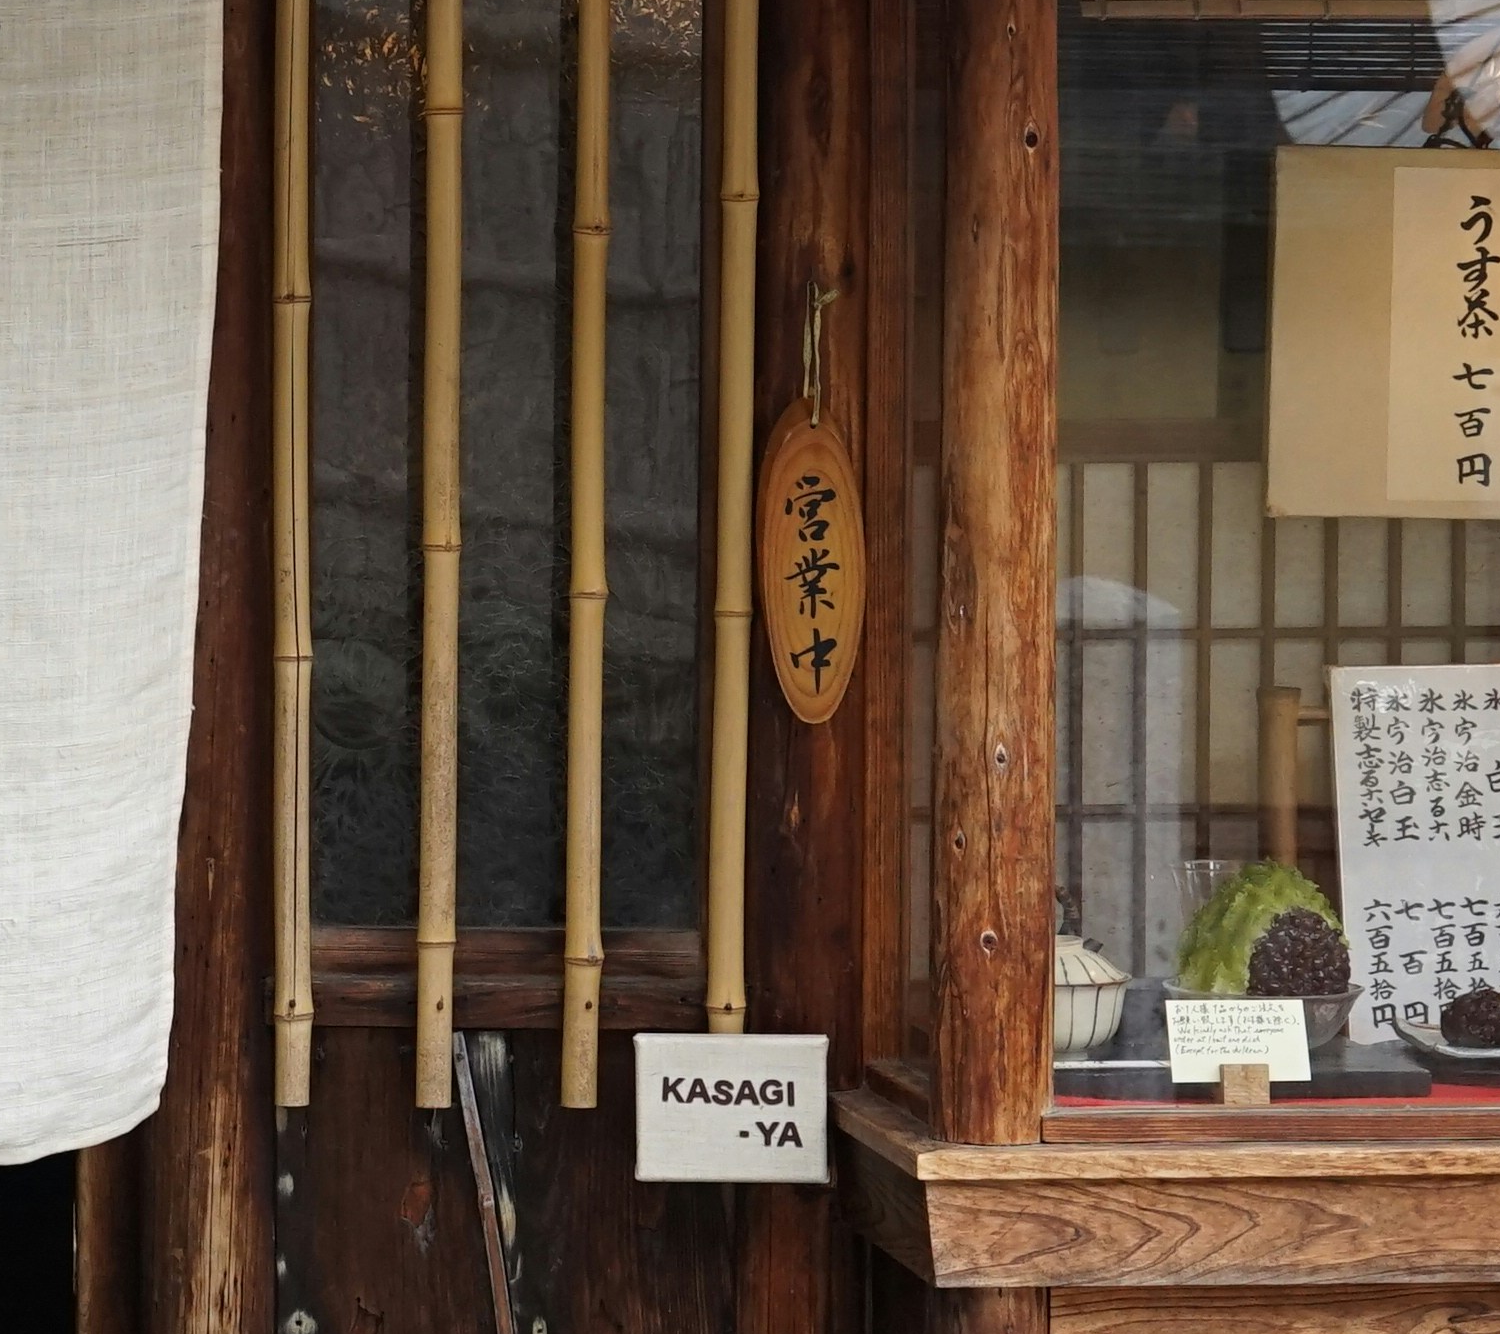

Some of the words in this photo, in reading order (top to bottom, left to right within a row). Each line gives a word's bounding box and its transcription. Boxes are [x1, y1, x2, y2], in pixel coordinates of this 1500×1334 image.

[1452, 363, 1494, 487] 七百円
[784, 475, 841, 695] 営業中
[1364, 899, 1396, 1028] 六百五拾円
[1394, 899, 1428, 1024] 七百円
[1427, 898, 1461, 1012] 七百五拾
[662, 1077, 795, 1107] KASAGI
[739, 1122, 803, 1148] -YA
